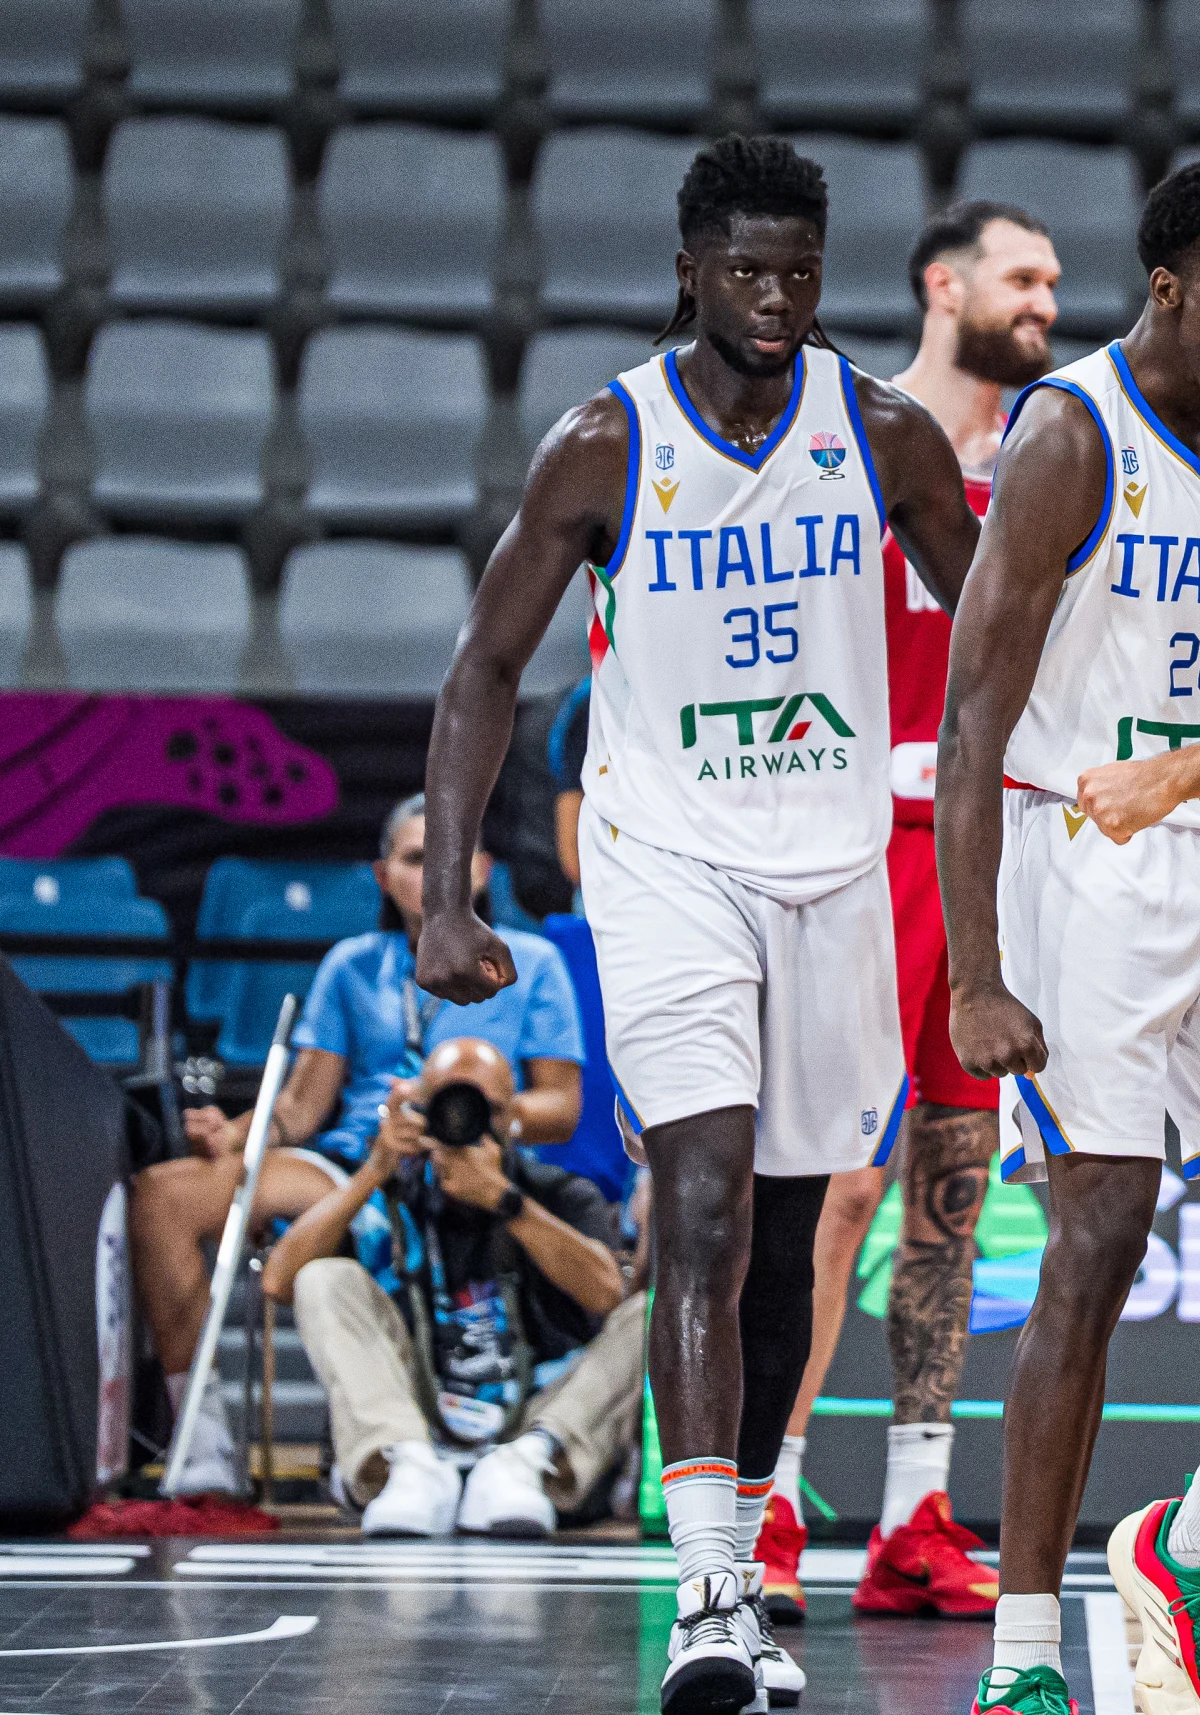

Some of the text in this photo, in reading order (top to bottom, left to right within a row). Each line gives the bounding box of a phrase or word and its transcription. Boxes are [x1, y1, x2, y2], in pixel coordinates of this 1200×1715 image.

[645, 514, 862, 593] ITALIA
[724, 602, 799, 669] 35
[680, 693, 857, 749] ITA
[697, 747, 848, 781] AIRWAYS
